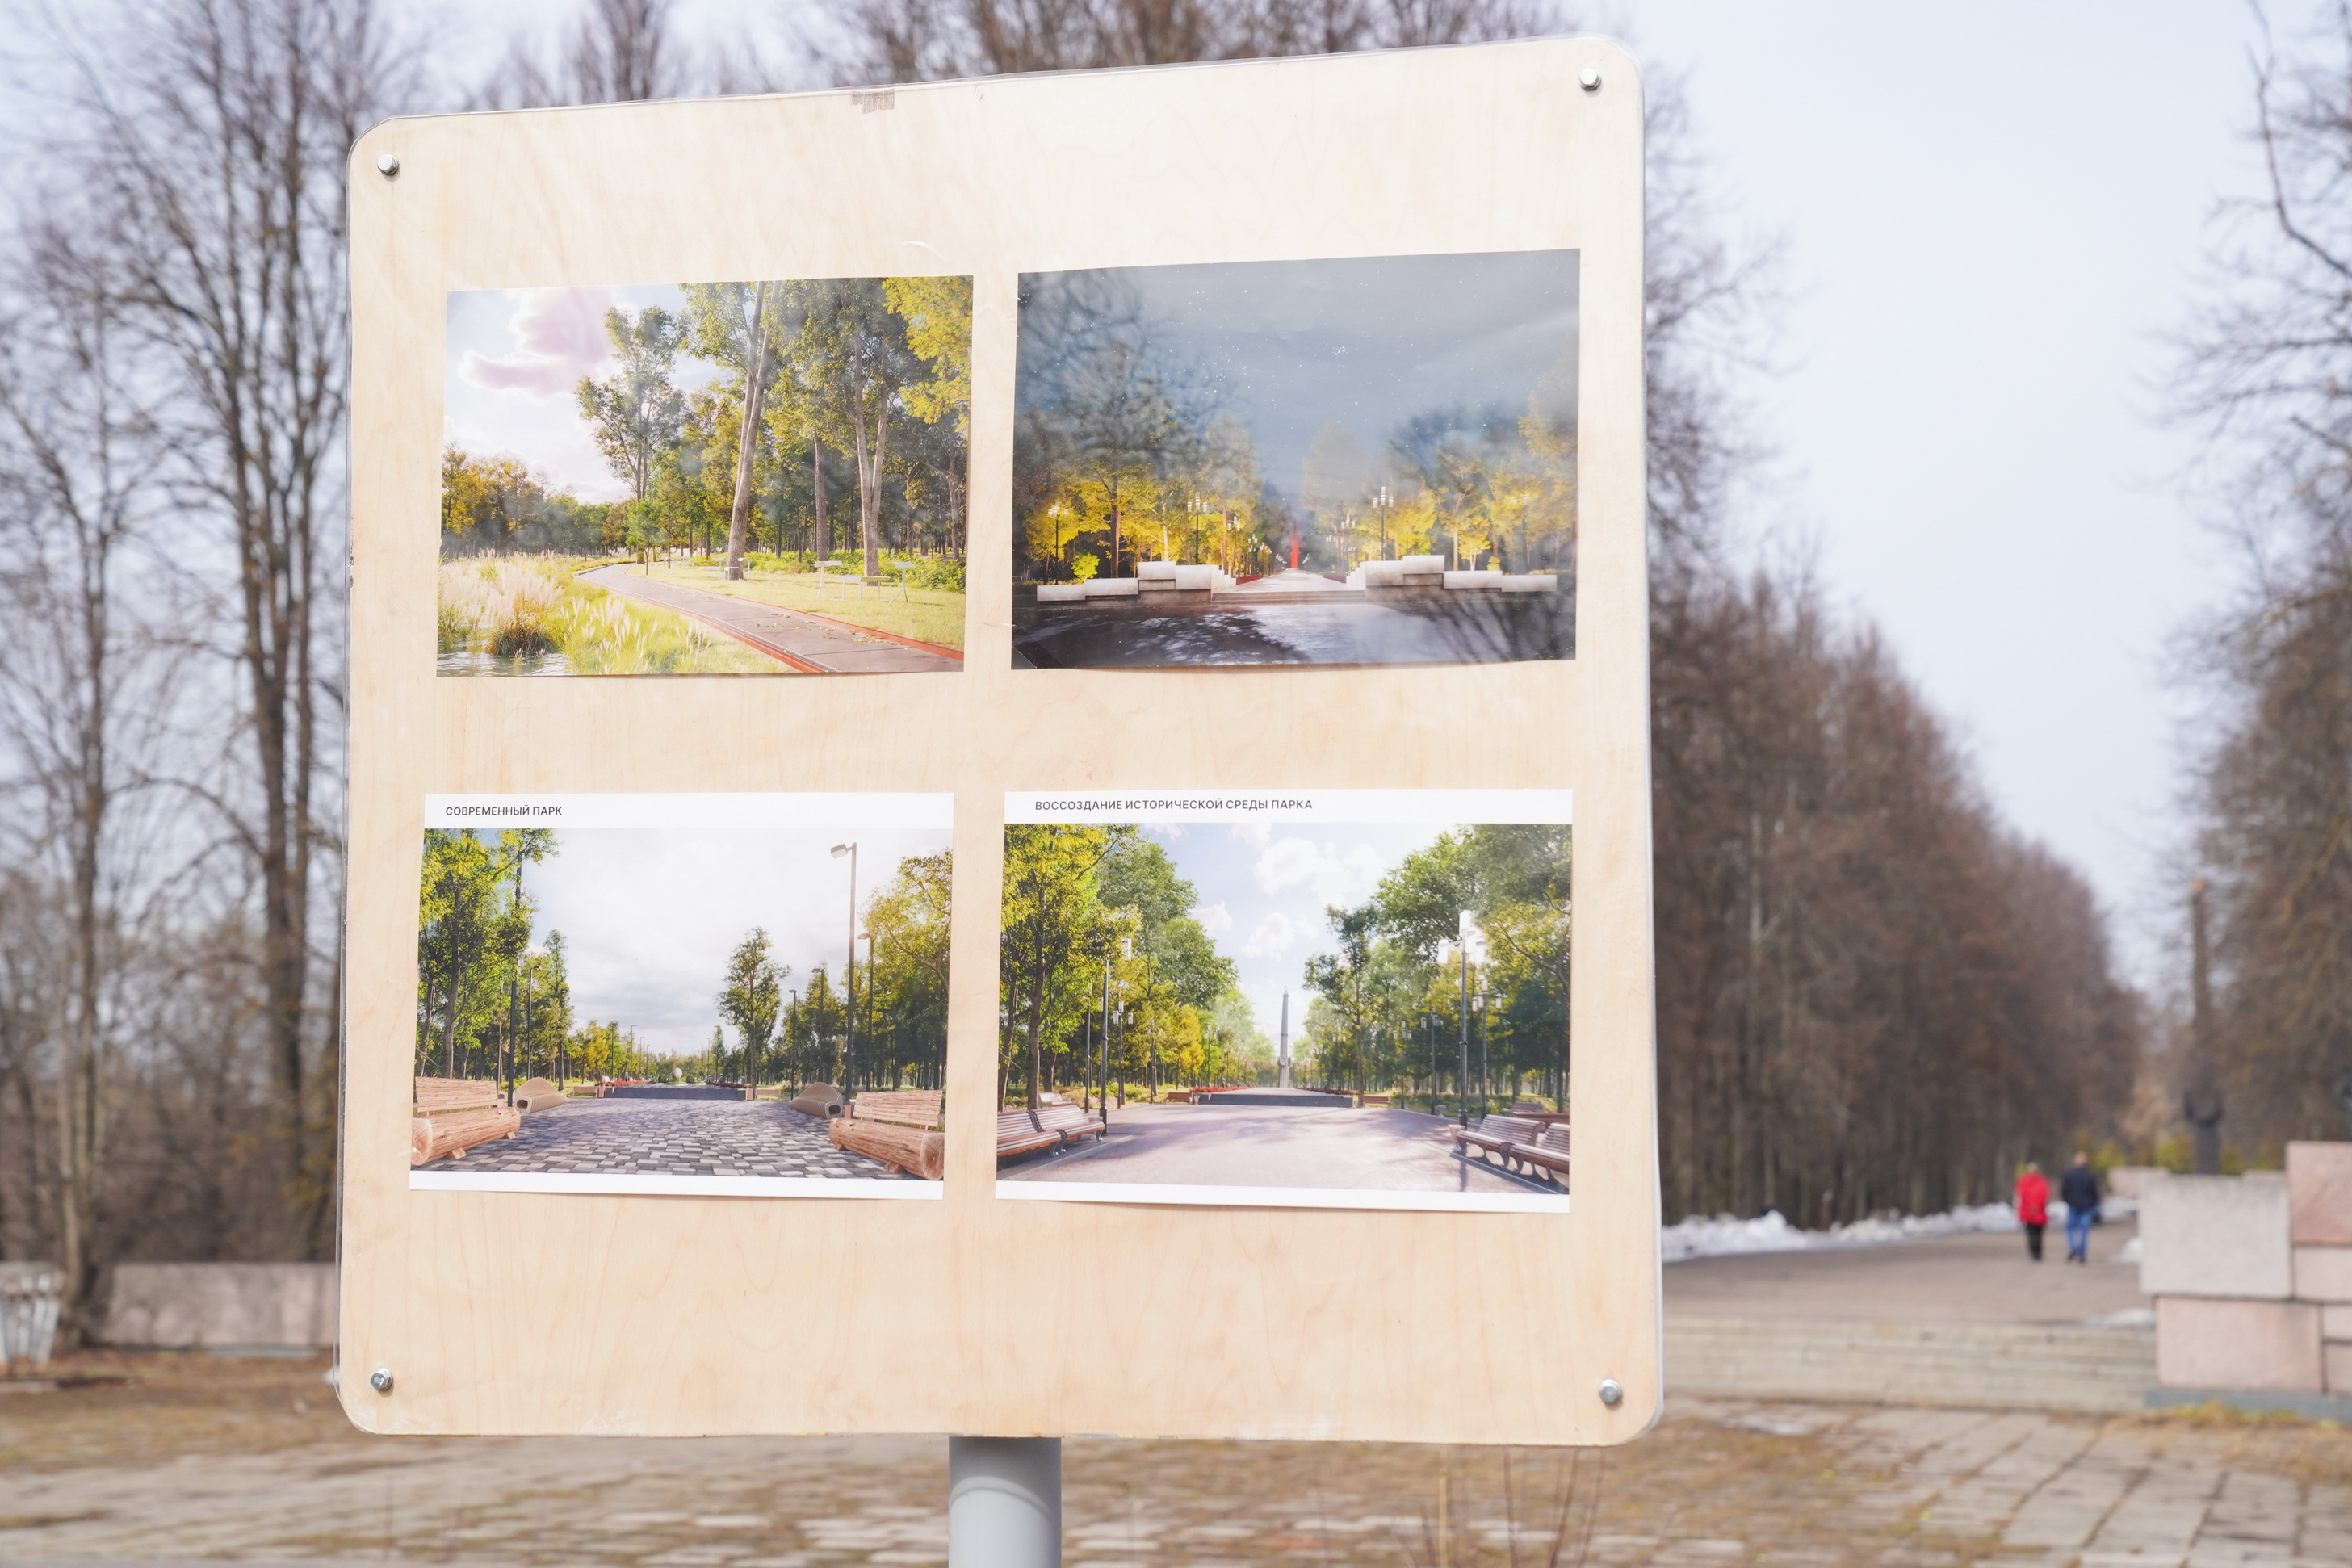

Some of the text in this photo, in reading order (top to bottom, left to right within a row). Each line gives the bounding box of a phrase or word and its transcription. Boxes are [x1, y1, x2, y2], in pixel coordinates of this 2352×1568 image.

[445, 804, 563, 816] СОВРЕМЕННЫЙ ПАРК
[1035, 798, 1313, 811] ВОССОЗДАНИЕ ИСТОРИЧЕСКОЙ СРЕДЫ ПАРКА
